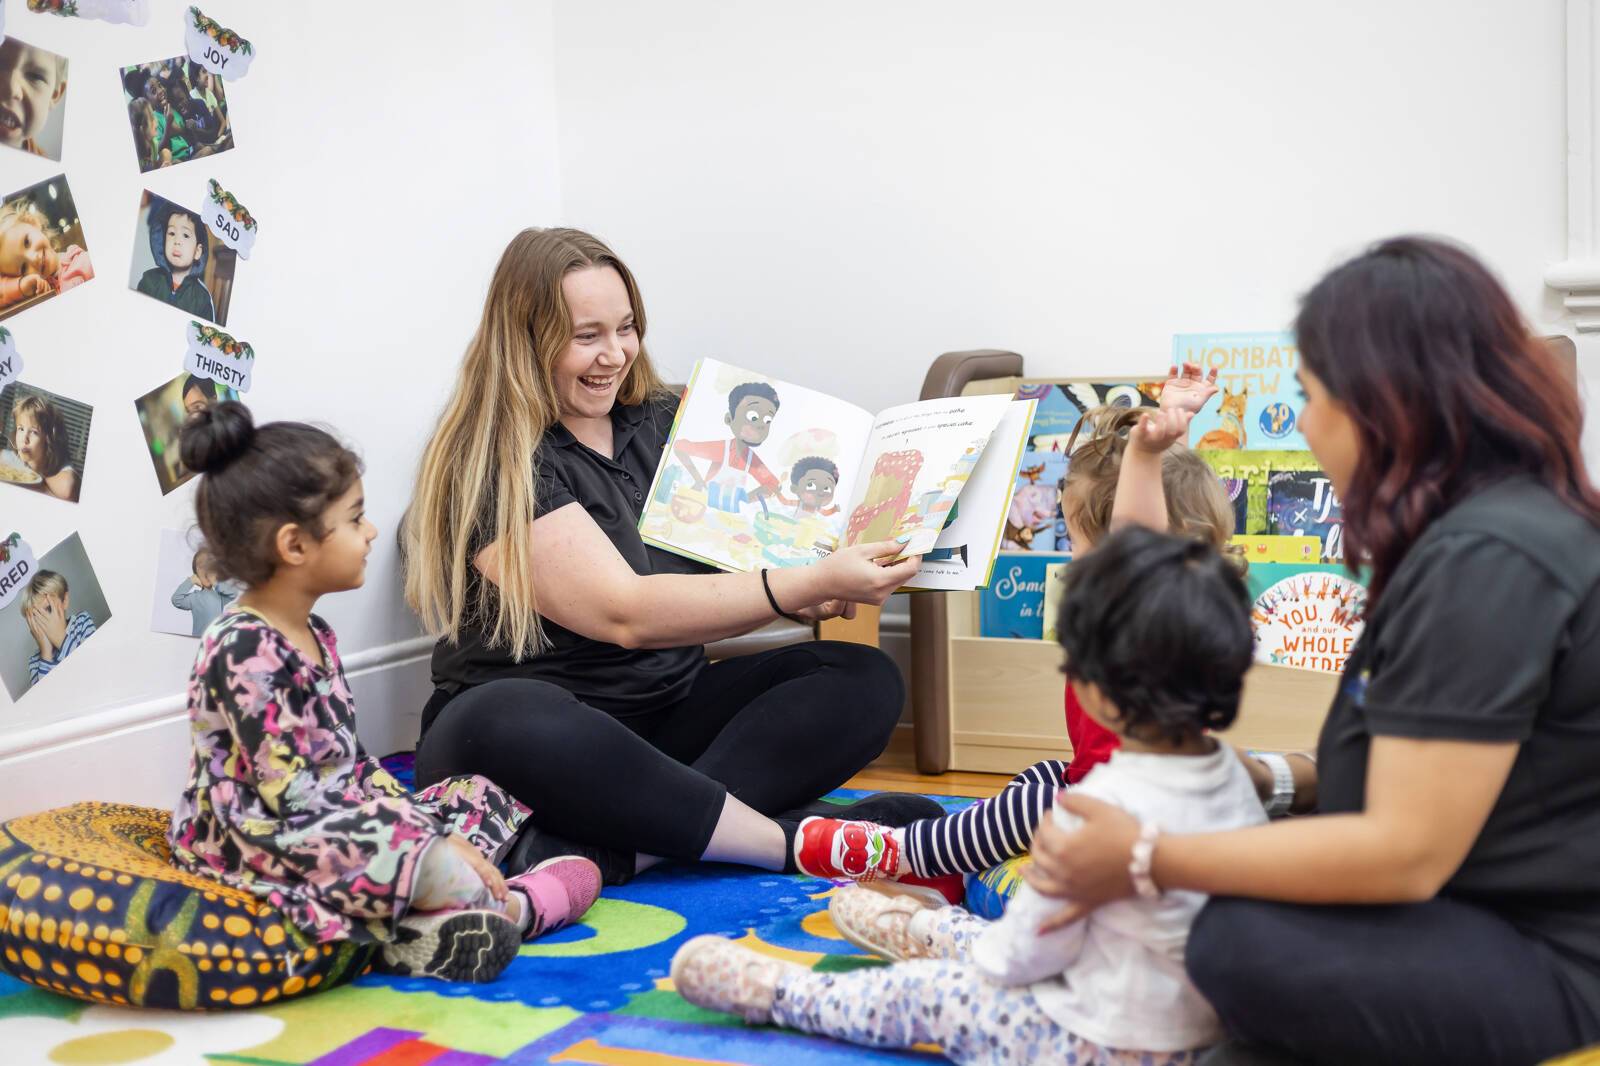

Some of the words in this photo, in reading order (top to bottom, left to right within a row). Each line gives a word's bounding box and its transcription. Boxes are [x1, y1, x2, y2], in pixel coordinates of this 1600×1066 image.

[203, 46, 229, 70] JOY
[215, 214, 240, 242] SAD
[1186, 345, 1299, 370] WOMBAT
[195, 353, 246, 387] THIRSTY
[1218, 372, 1281, 397] TEW
[1020, 603, 1033, 617] in
[1302, 625, 1319, 634] and
[1283, 635, 1354, 654] WHOLE
